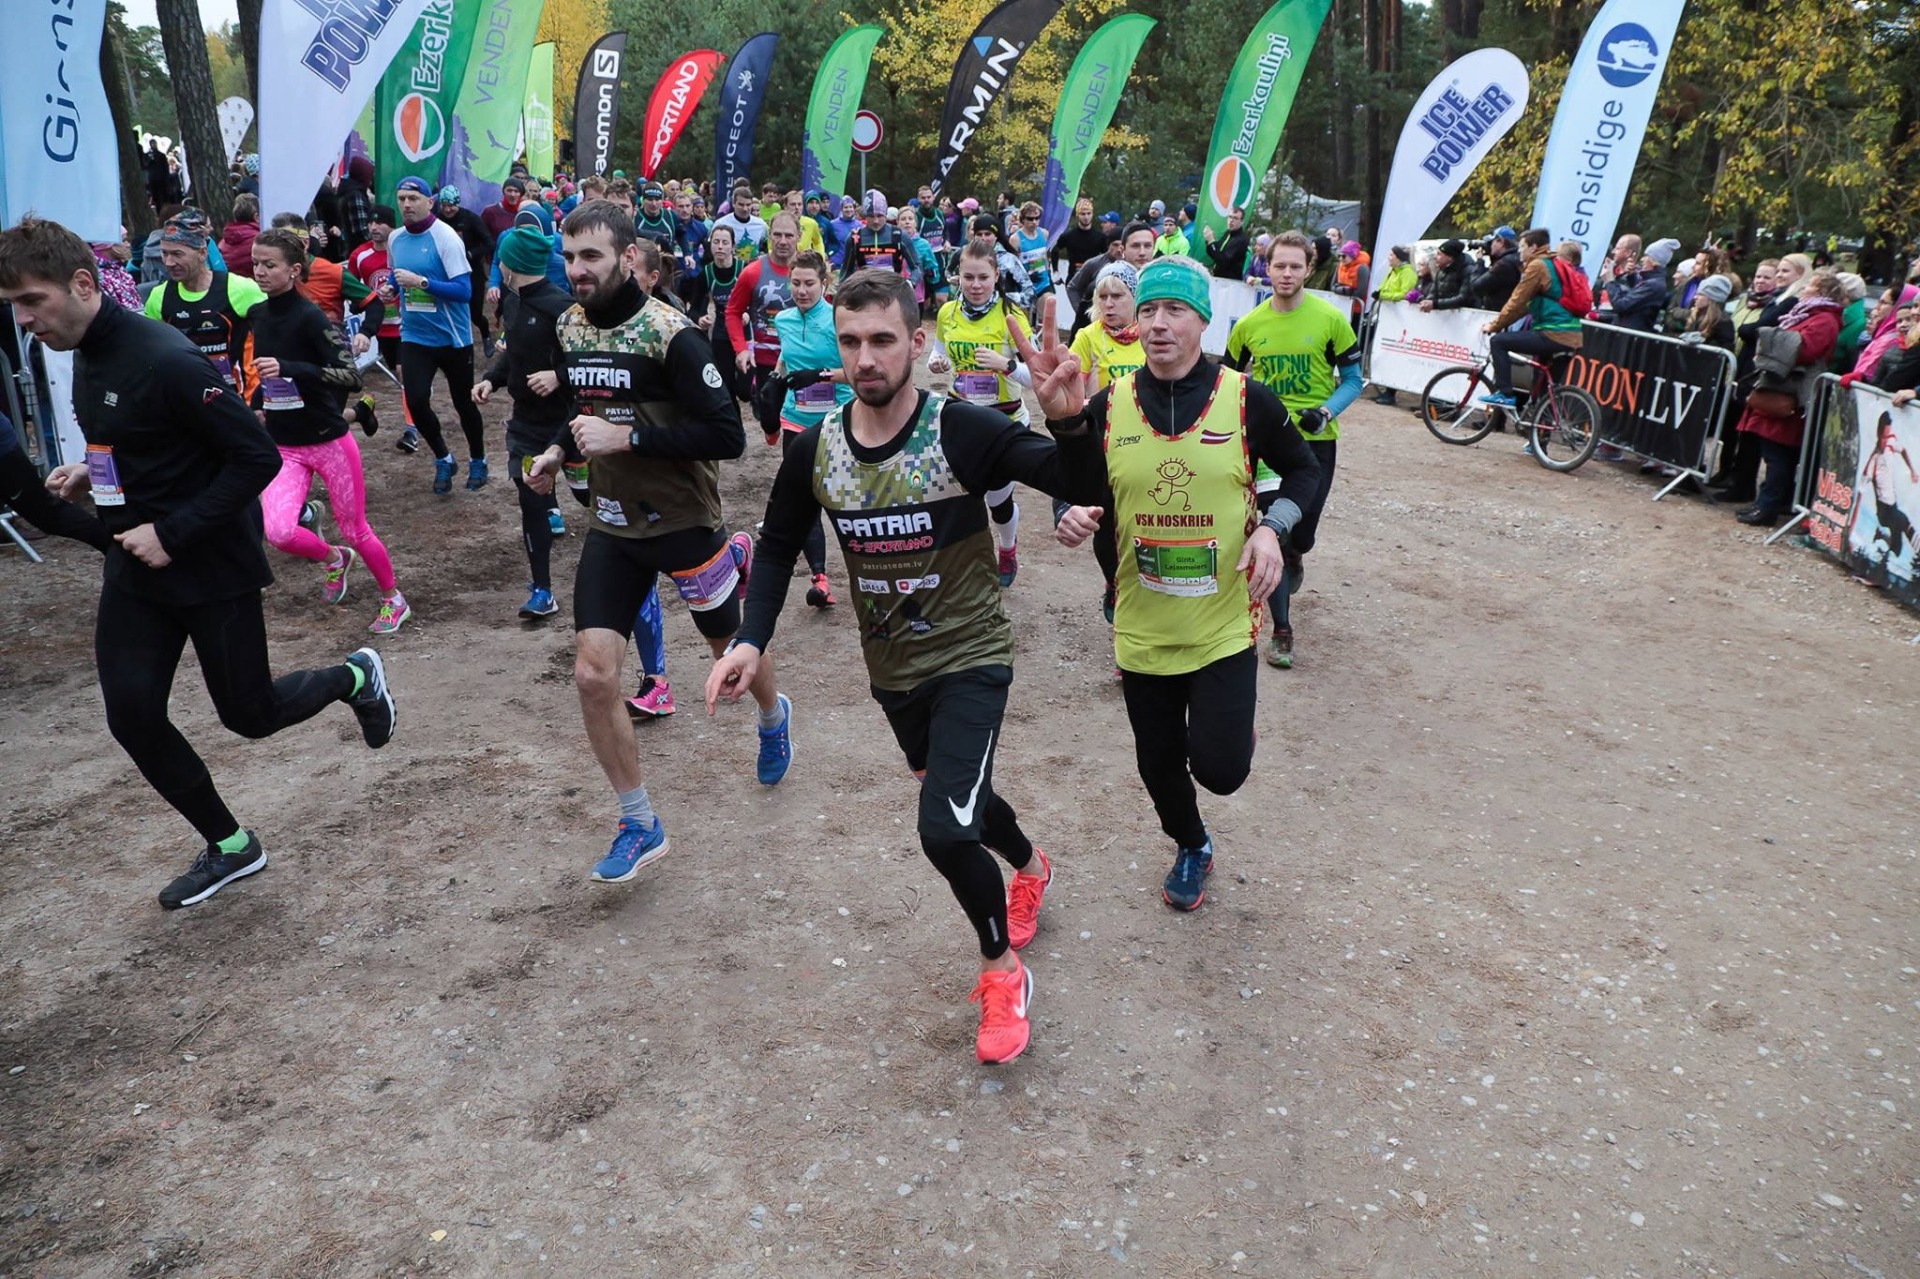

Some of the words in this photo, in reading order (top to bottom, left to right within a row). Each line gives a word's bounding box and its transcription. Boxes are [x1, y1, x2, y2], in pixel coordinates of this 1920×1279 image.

[823, 67, 848, 143] VENDEN
[1072, 63, 1110, 152] VENDEN
[1231, 33, 1292, 157] Ezerkauliņi
[1417, 85, 1471, 140] ICE
[1420, 82, 1516, 183] POWER
[568, 367, 631, 389] PATRIA
[1818, 468, 1852, 509] Viss
[837, 512, 933, 537] PATRIA
[864, 536, 934, 553] SPORTLAND
[1135, 514, 1153, 526] VSK
[1157, 514, 1213, 527] NOSKRIEN
